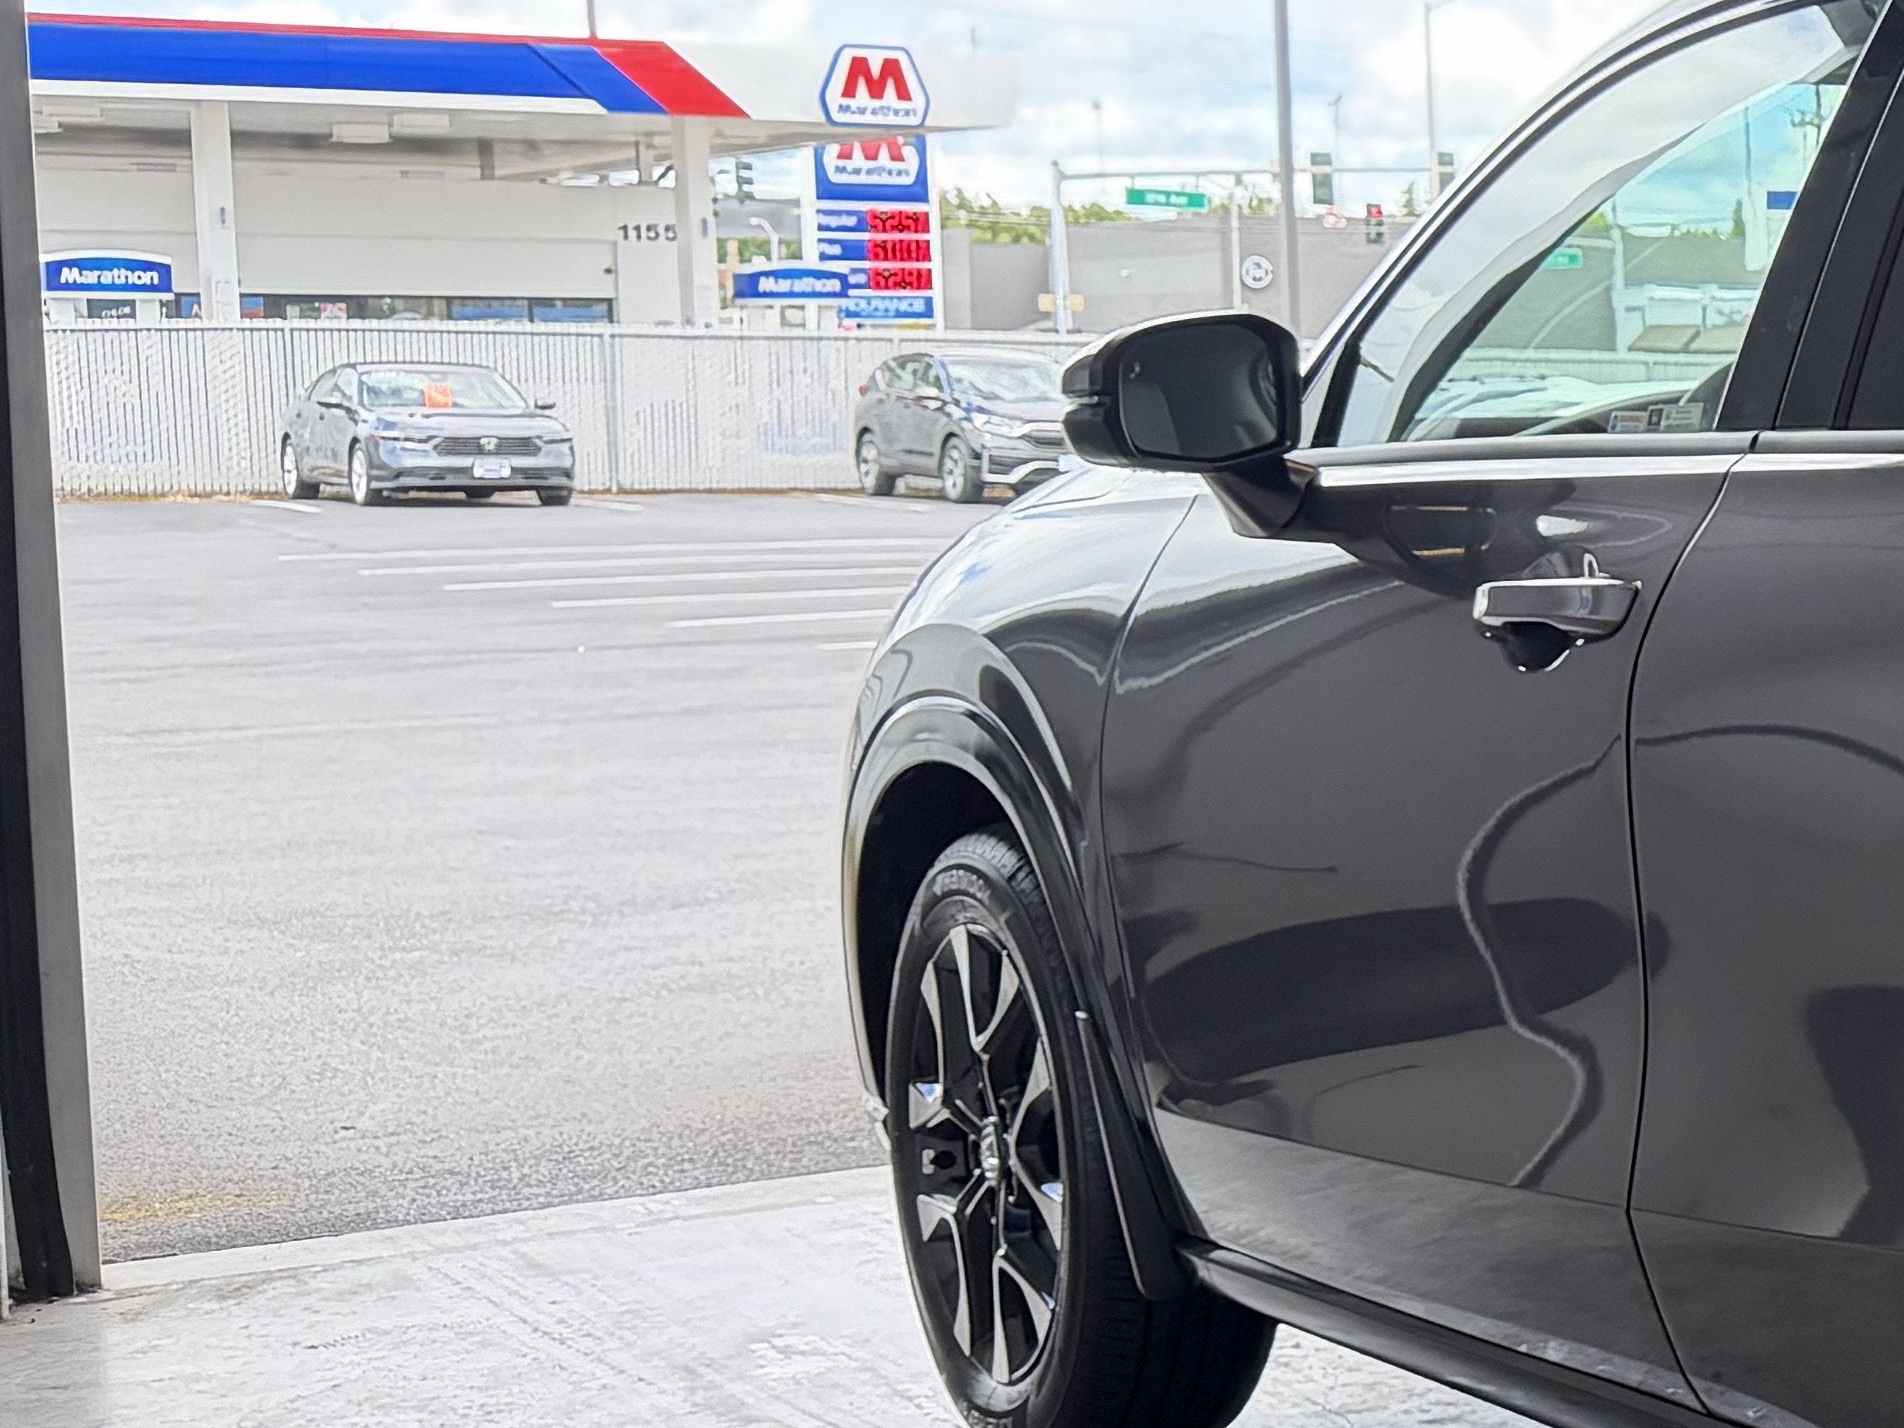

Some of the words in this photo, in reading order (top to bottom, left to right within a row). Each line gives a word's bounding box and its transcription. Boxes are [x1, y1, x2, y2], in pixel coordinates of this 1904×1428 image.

[617, 223, 678, 242] 1155
[60, 267, 159, 285] Marathon
[758, 275, 841, 293] Marathon
